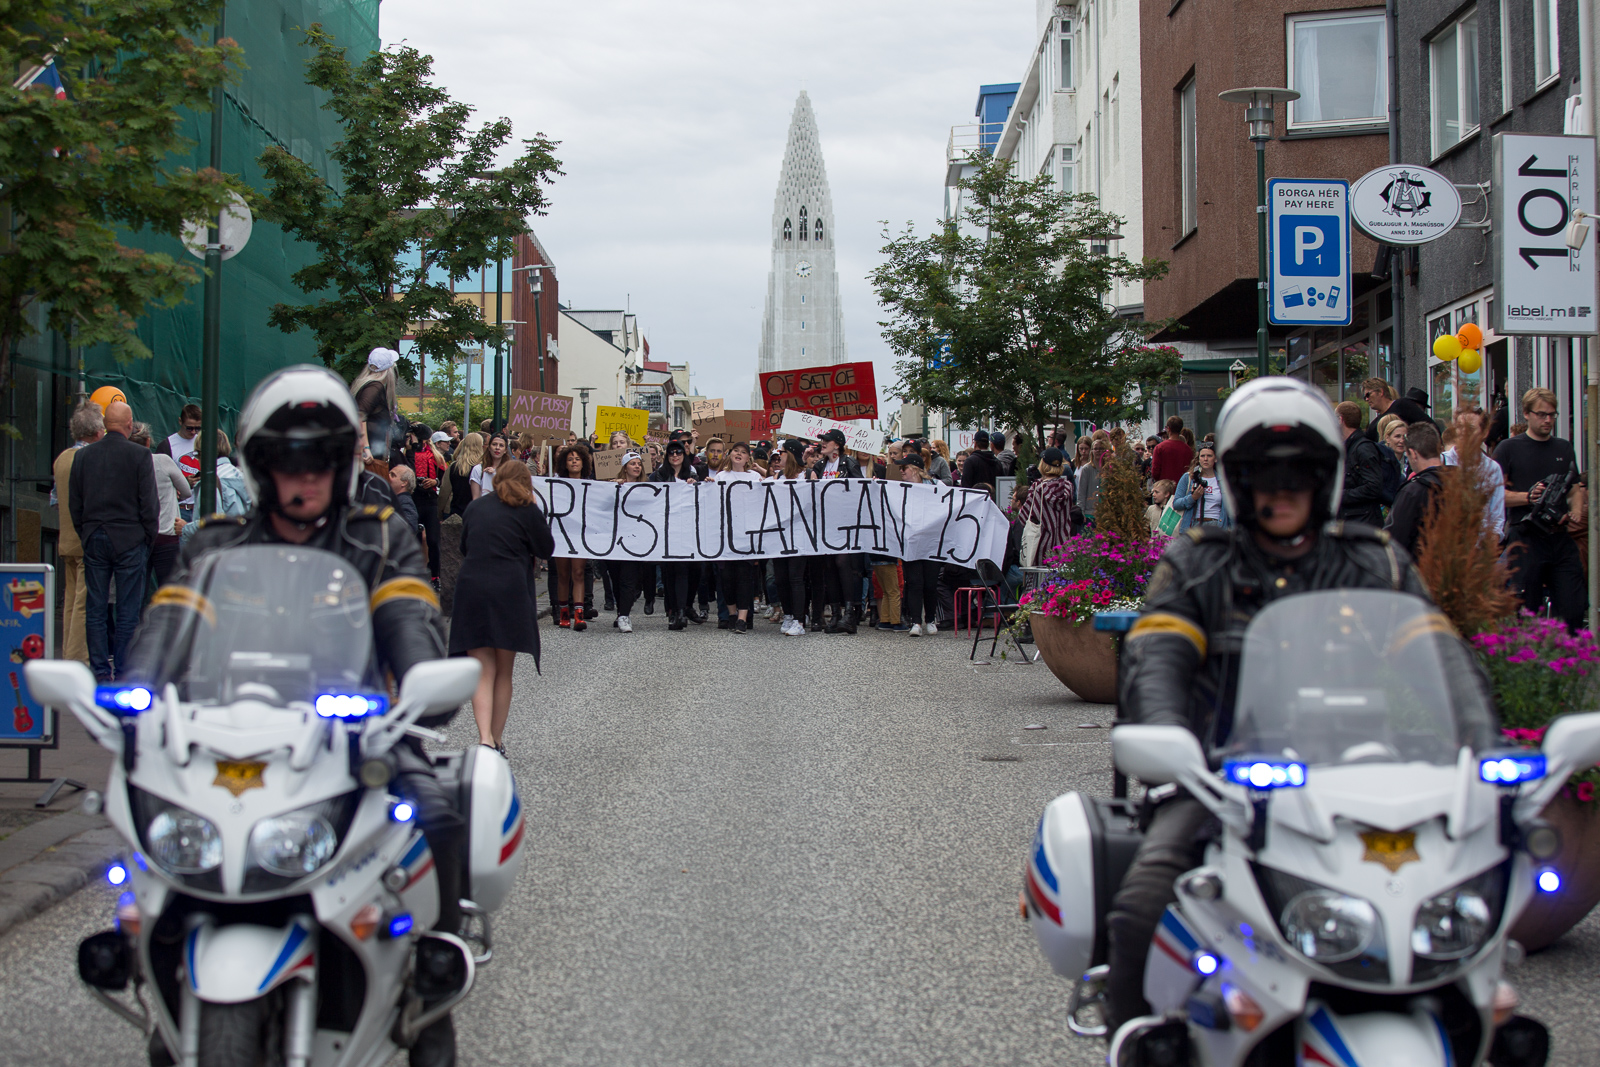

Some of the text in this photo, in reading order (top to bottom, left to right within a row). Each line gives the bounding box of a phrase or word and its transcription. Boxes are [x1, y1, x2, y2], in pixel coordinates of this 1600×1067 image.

[1278, 187, 1340, 198] BORGA HÉR
[1285, 200, 1335, 209] PAY HERE
[1518, 154, 1569, 271] 101
[1294, 225, 1325, 266] P 1
[1507, 304, 1567, 317] label.m
[766, 369, 855, 396] OF SÆT OF
[513, 395, 572, 415] MY PUSSY
[771, 391, 860, 411] FULL OF EIN
[512, 413, 571, 431] MY CHOICE
[818, 407, 833, 418] OF
[928, 487, 990, 564] '15
